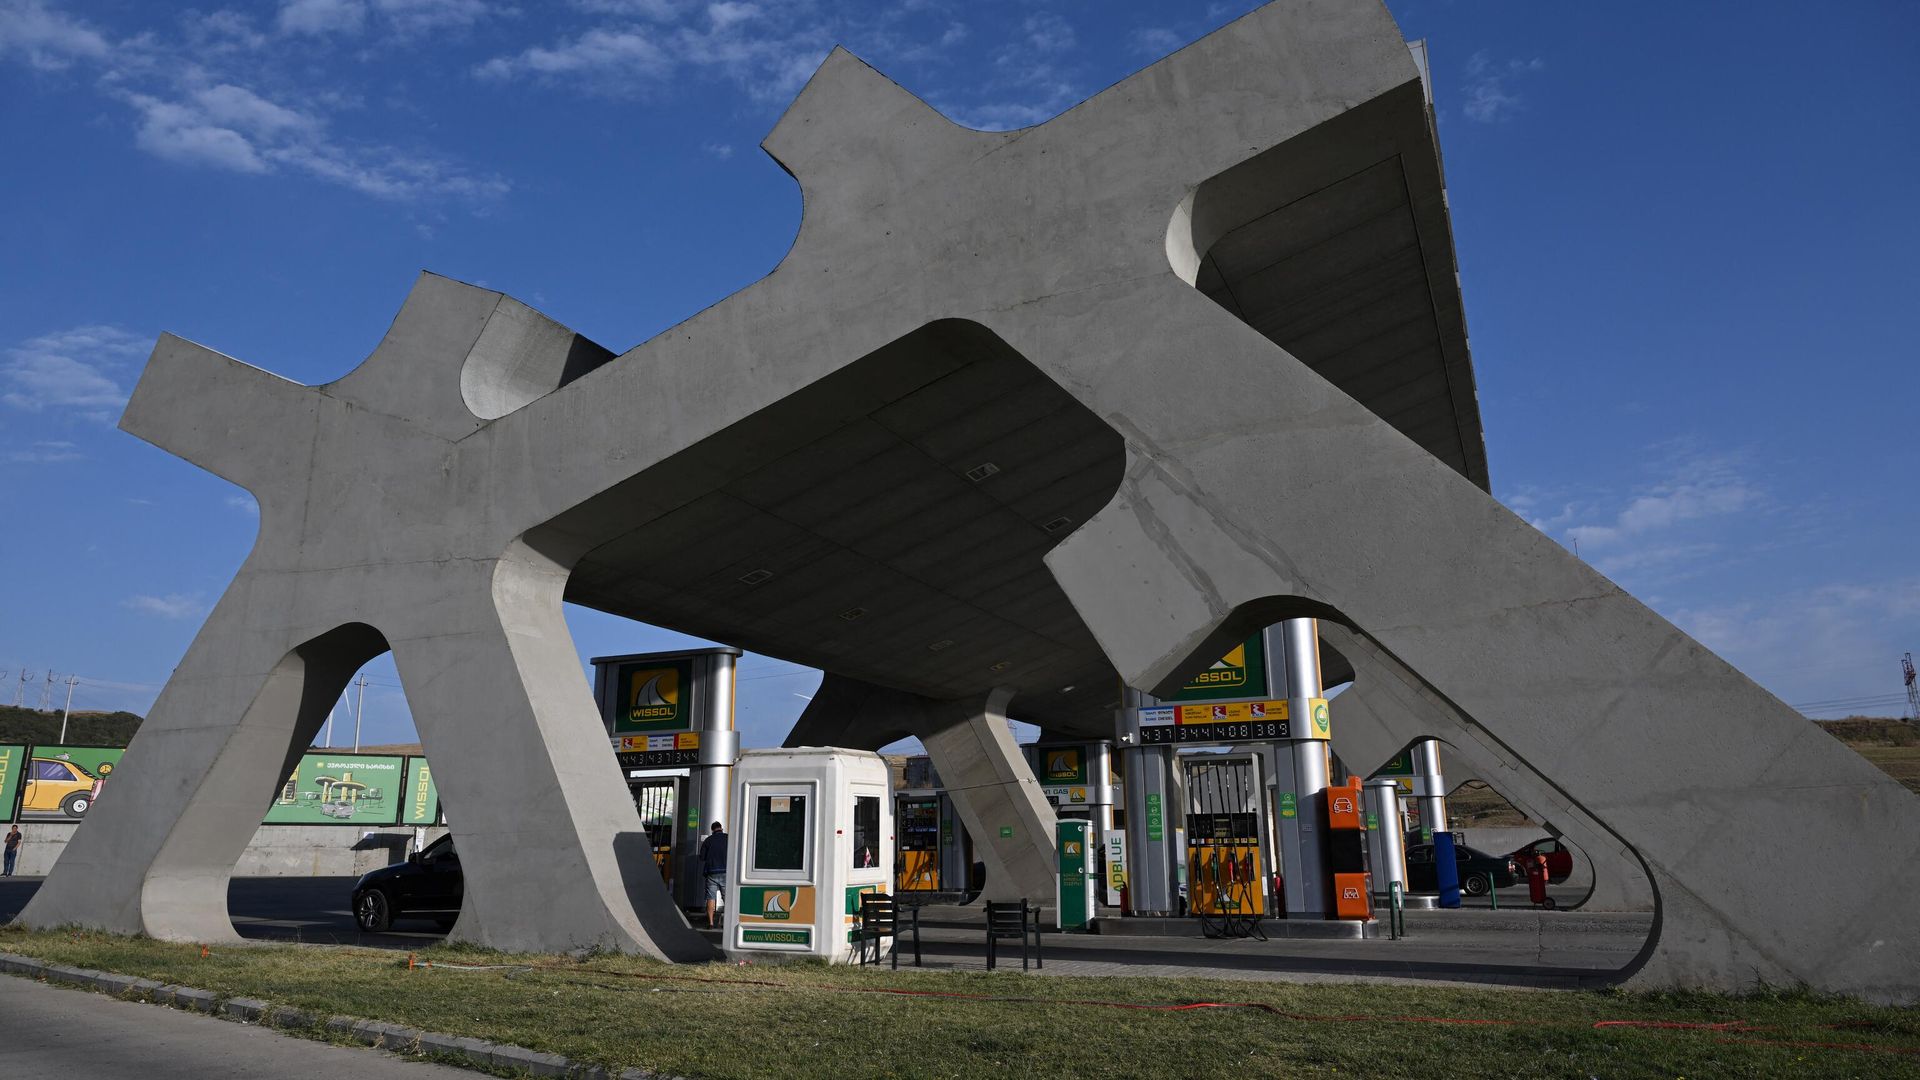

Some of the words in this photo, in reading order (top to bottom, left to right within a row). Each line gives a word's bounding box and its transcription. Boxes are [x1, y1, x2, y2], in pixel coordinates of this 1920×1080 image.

[1190, 671, 1242, 684] ISSOL
[632, 707, 674, 718] WISSOL
[1142, 728, 1171, 740] 437
[1180, 727, 1209, 740] 344
[1217, 725, 1248, 737] 408
[1257, 723, 1287, 736] 389
[1111, 837, 1124, 892] ADBLUE
